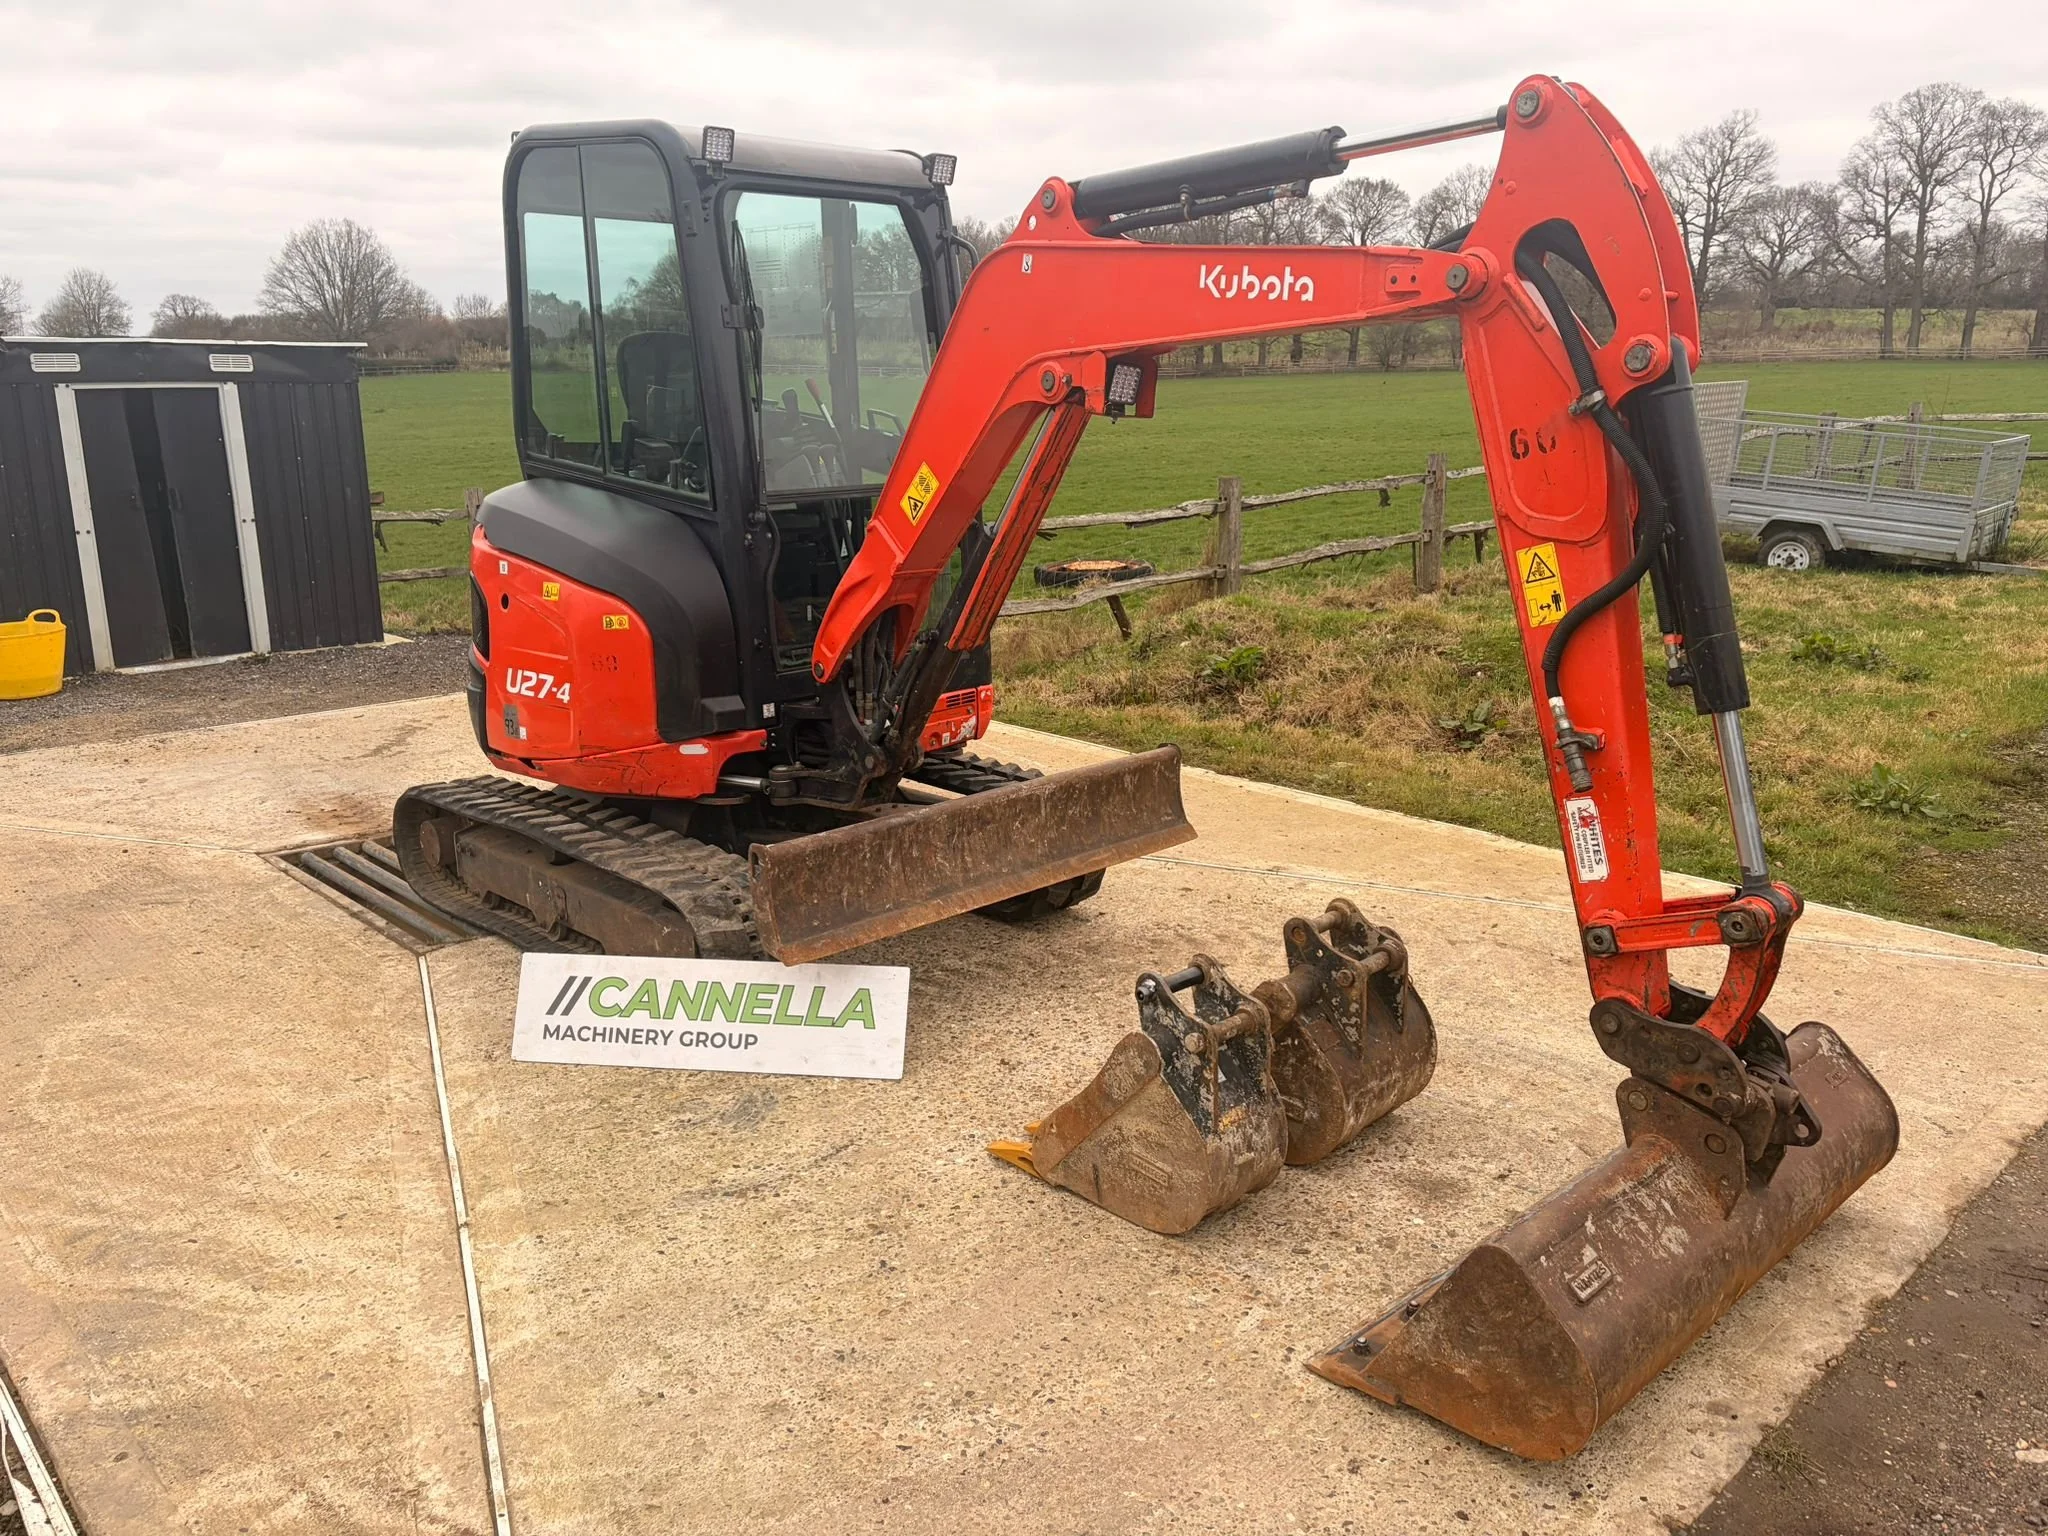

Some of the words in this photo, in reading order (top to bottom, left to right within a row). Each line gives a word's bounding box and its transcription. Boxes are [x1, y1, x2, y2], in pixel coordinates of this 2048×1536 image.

[1199, 264, 1315, 301] Kubota
[505, 667, 571, 704] U27-4
[542, 1023, 674, 1047] MACHINERY
[679, 1030, 759, 1051] GROUP
